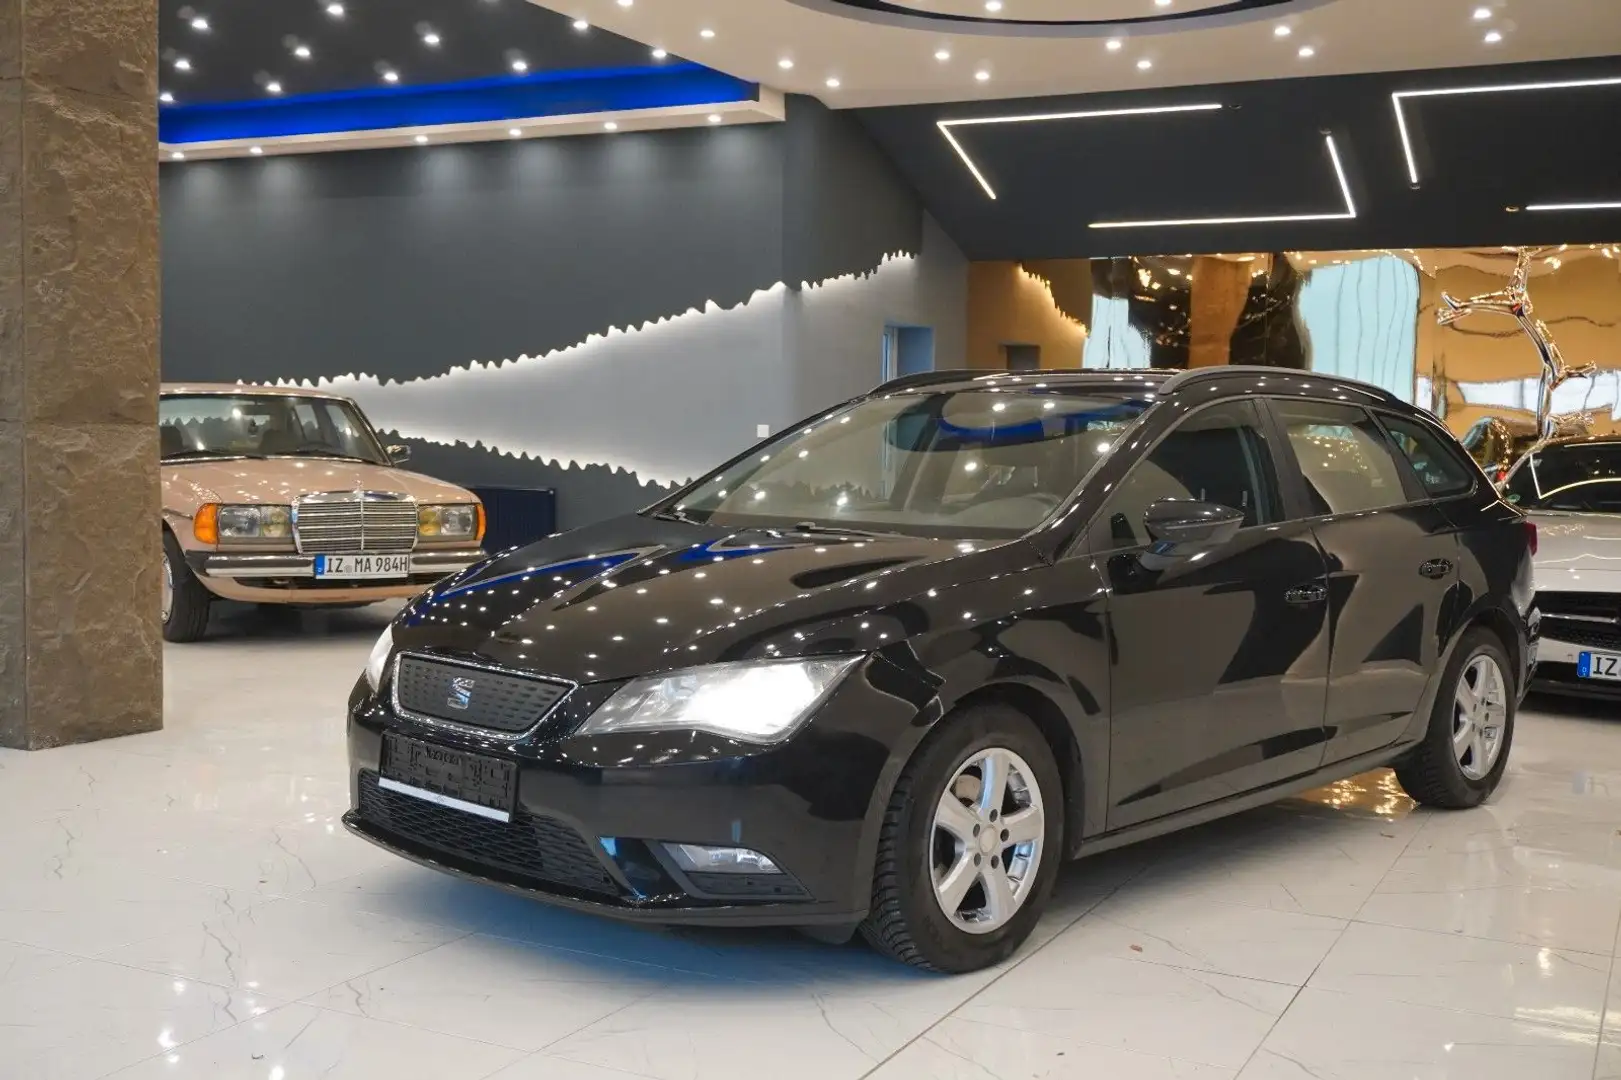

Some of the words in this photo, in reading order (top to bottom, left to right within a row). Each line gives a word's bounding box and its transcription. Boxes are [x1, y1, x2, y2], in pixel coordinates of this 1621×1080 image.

[327, 558, 343, 573] IZ
[354, 557, 371, 573] MA
[376, 557, 408, 572] 984H
[1593, 656, 1617, 676] IZ
